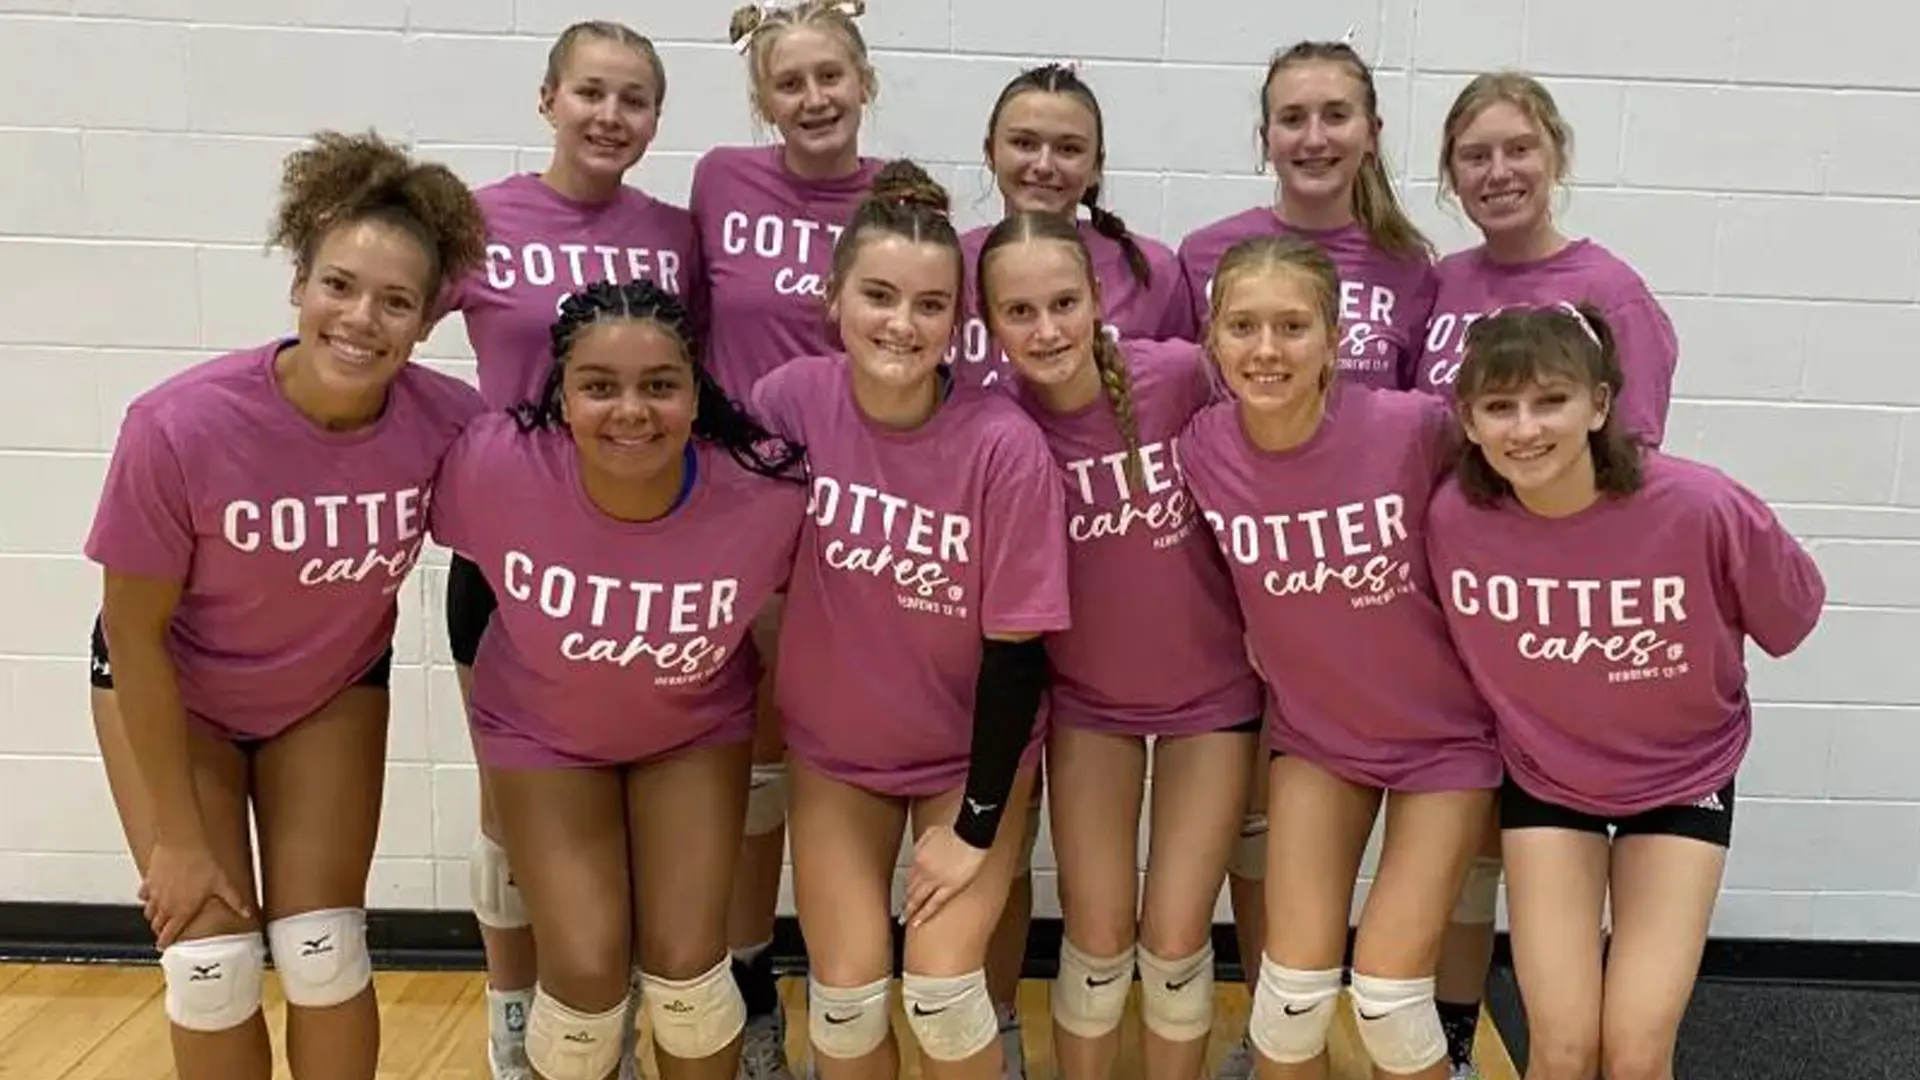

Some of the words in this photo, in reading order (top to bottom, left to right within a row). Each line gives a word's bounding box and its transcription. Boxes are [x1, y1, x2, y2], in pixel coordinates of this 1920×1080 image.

[723, 211, 845, 264] COTT
[485, 243, 680, 294] COTTER
[1066, 437, 1182, 505] TTE
[224, 488, 431, 552] COTTE
[806, 476, 971, 562] OTTER
[1069, 490, 1187, 542] cares
[504, 550, 738, 633] COTTER
[825, 539, 949, 596] cares
[1264, 555, 1399, 595] cares
[1451, 568, 1687, 628] COTTER
[560, 632, 714, 673] cares
[1518, 630, 1667, 667] cares
